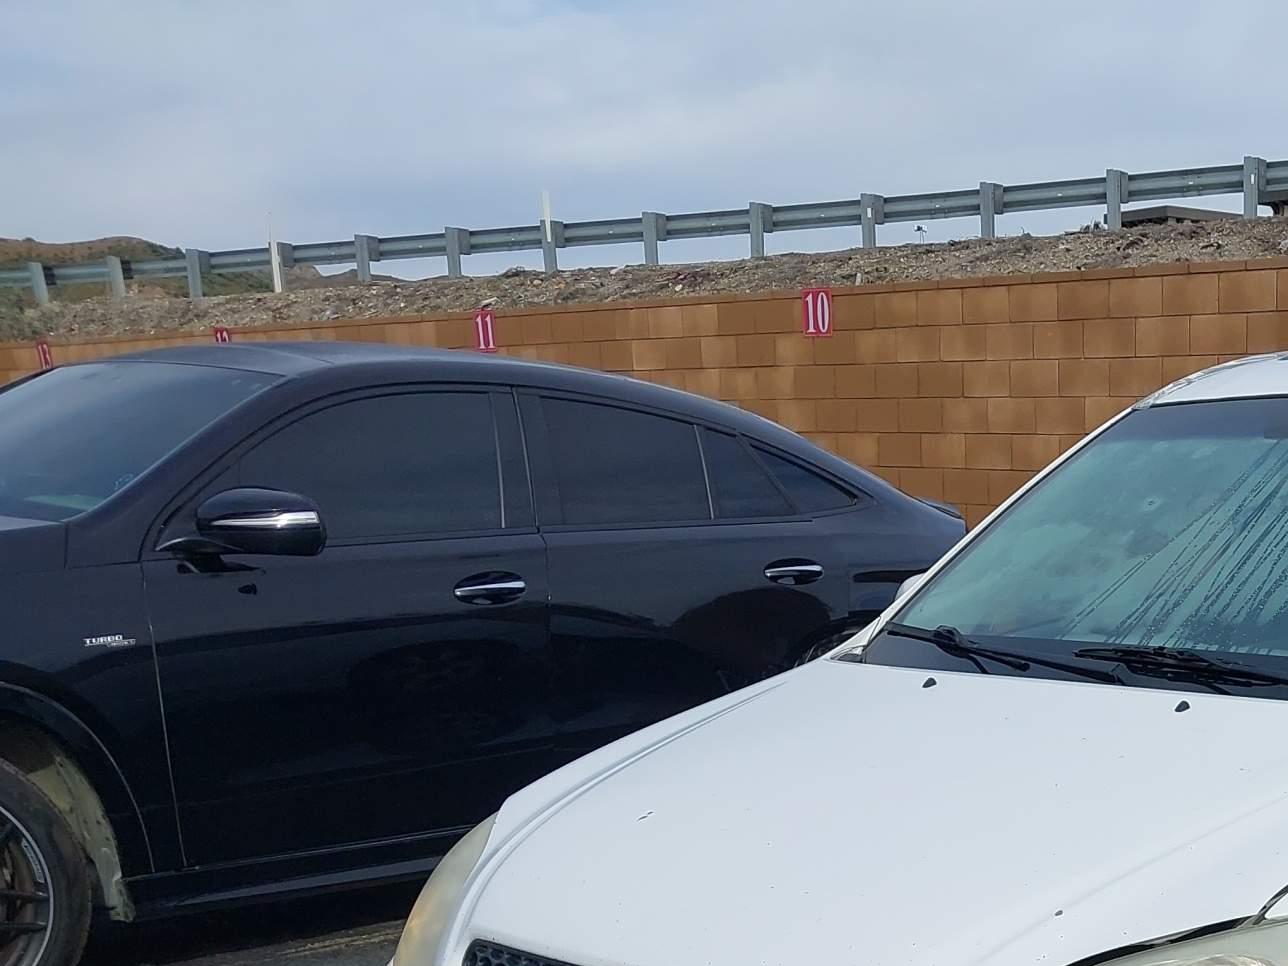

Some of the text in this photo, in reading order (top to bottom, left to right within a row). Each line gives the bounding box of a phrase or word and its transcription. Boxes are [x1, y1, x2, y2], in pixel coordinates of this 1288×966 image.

[804, 292, 829, 333] 10
[476, 314, 495, 349] 11
[83, 634, 123, 643] TURBO
